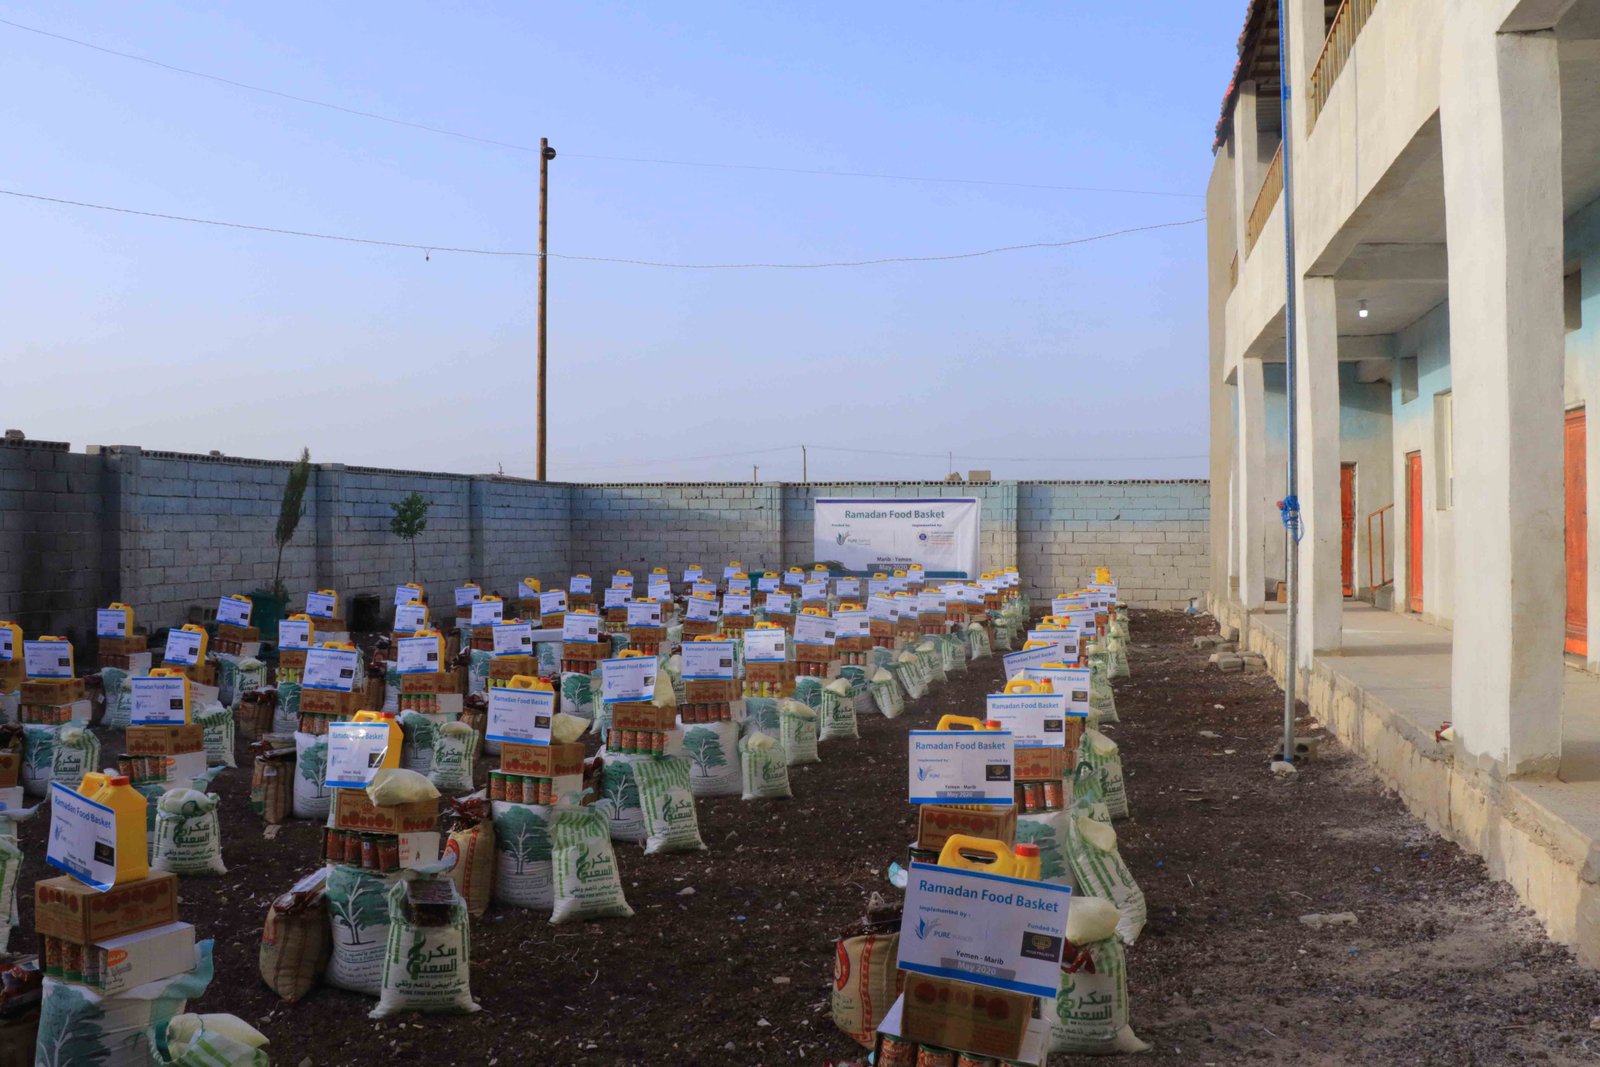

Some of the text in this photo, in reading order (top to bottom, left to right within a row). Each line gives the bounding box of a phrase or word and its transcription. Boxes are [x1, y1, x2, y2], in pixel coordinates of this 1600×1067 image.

[845, 510, 944, 519] Ramadan Food Basket
[77, 807, 90, 820] Food
[90, 813, 111, 829] Basket
[188, 821, 209, 836] سكر
[592, 852, 610, 868] سكر
[920, 880, 1058, 912] Ramadan Food Basket
[934, 930, 950, 939] PURE
[1027, 923, 1050, 931] Funded
[427, 944, 457, 963] سكر
[956, 950, 978, 960] Yemen
[984, 955, 1004, 965] Marib
[957, 959, 997, 975] May 2020
[1078, 991, 1112, 1009] سكر
